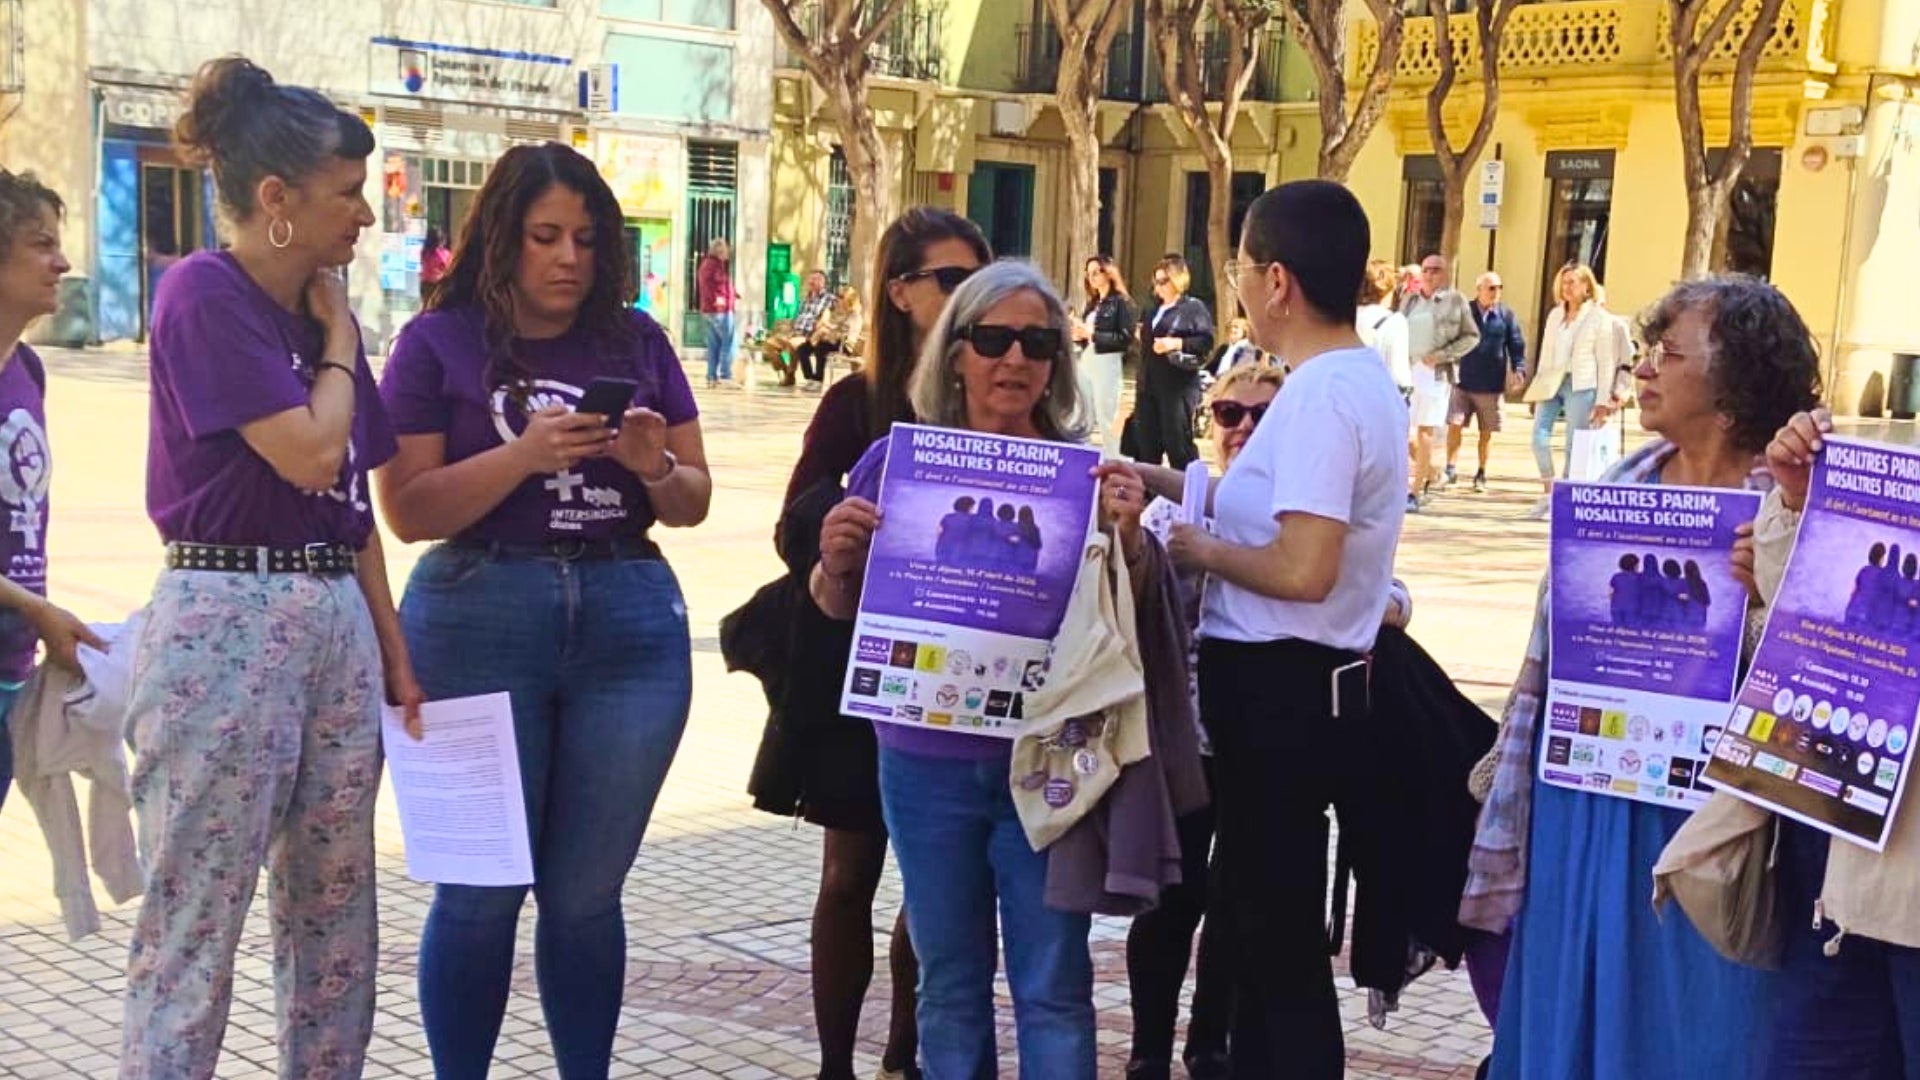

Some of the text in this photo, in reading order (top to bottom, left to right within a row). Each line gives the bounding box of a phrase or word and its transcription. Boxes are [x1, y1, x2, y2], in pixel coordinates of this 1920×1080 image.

[1560, 159, 1601, 169] SAONA
[912, 431, 1064, 466] NOSALTRES PARIM,
[1826, 445, 1889, 474] NOSALTRES
[914, 450, 1057, 479] NOSALTRES DECIDIM
[1826, 469, 1881, 496] NOSALTRES
[1571, 487, 1721, 514] NOSALTRES PARIM,
[1574, 506, 1714, 529] NOSALTRES DECIDIM
